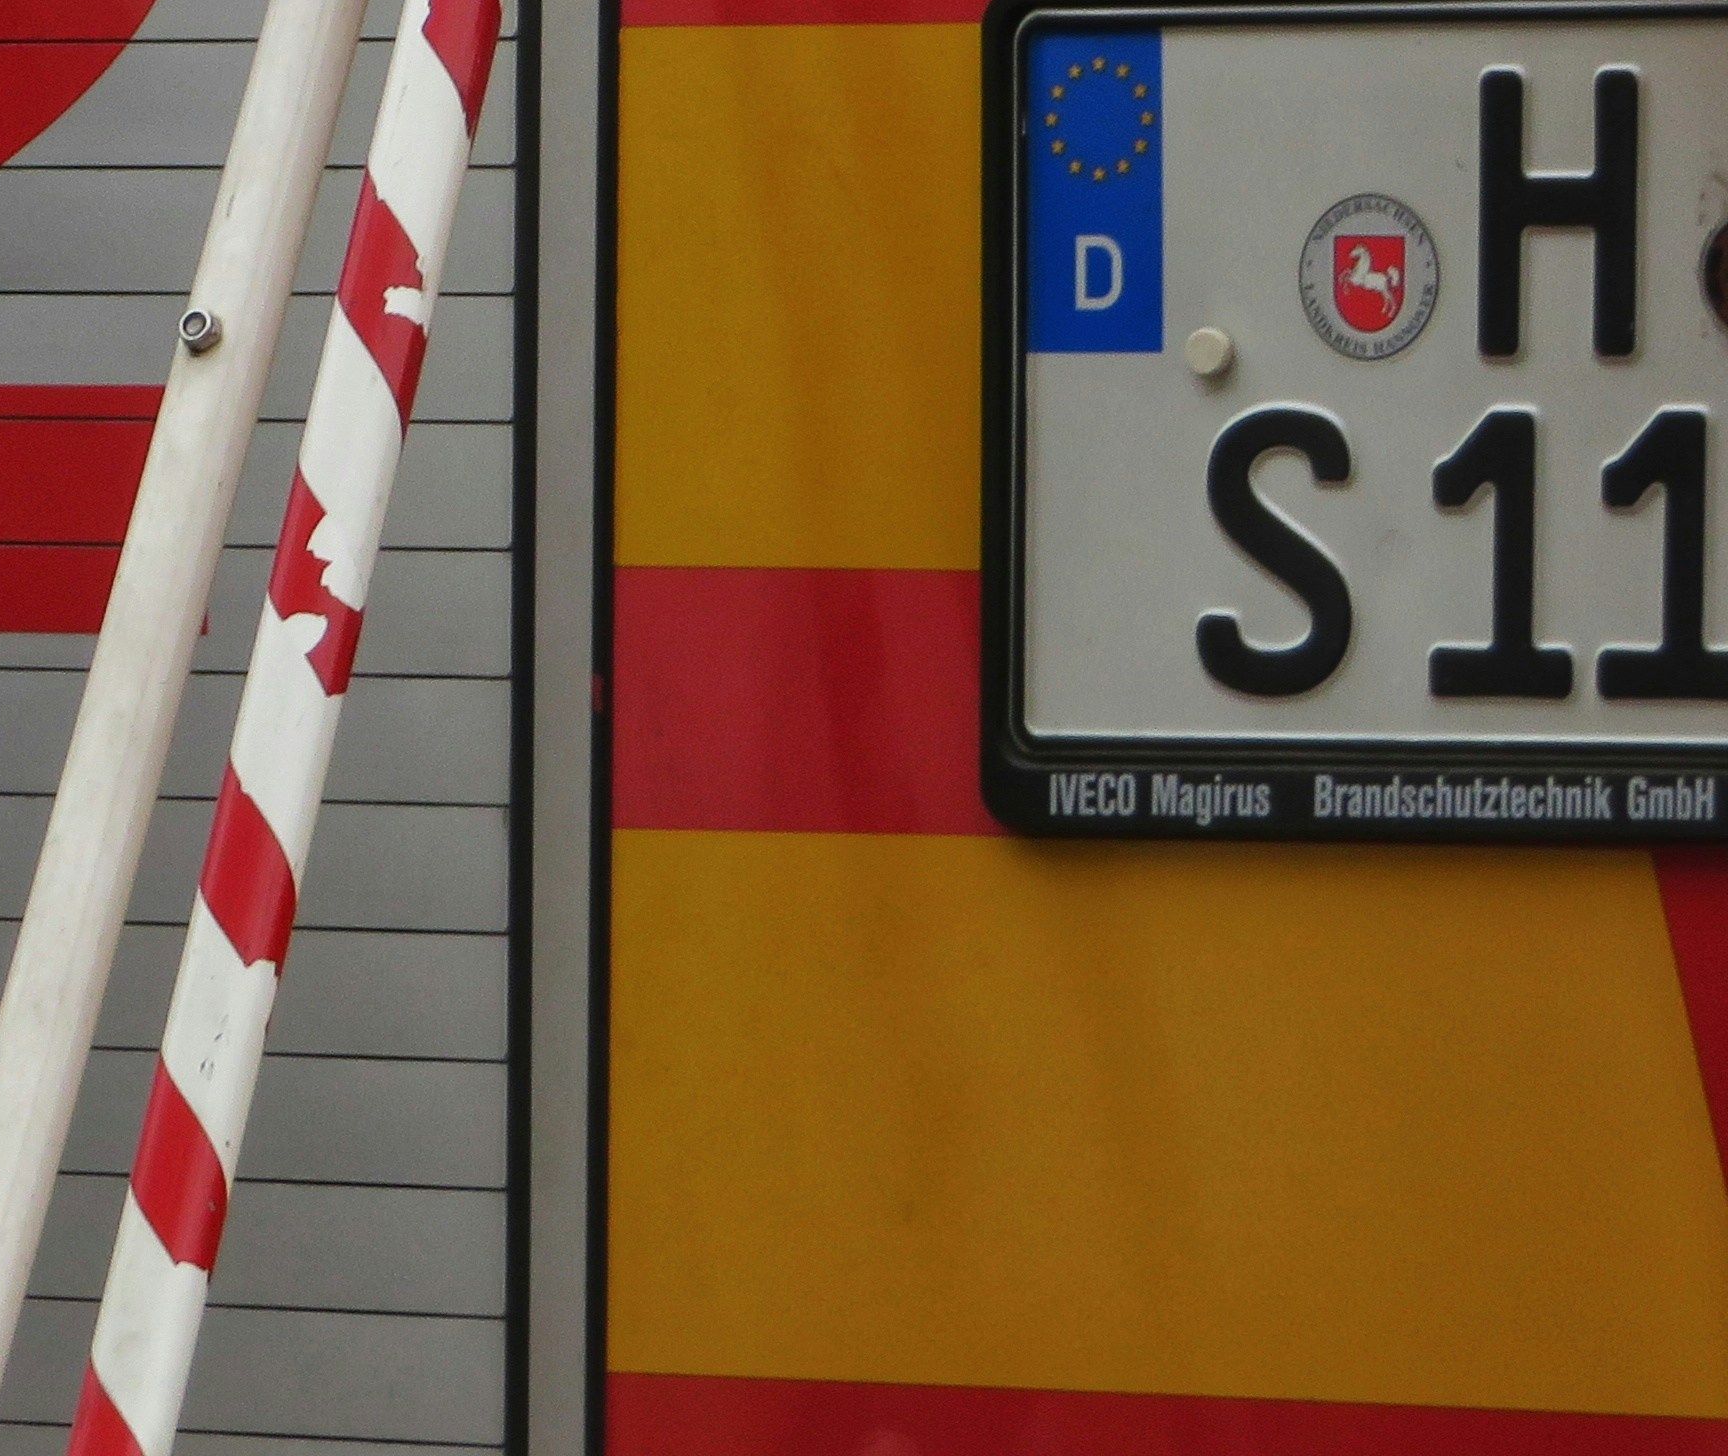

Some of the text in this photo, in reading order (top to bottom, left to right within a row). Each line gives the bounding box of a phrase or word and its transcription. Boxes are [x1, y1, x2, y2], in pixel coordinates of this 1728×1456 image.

[1478, 66, 1639, 357] H
[1075, 234, 1122, 310] D
[1049, 772, 1716, 826] IVECO Magirus Brandschutztechnik GmbH
